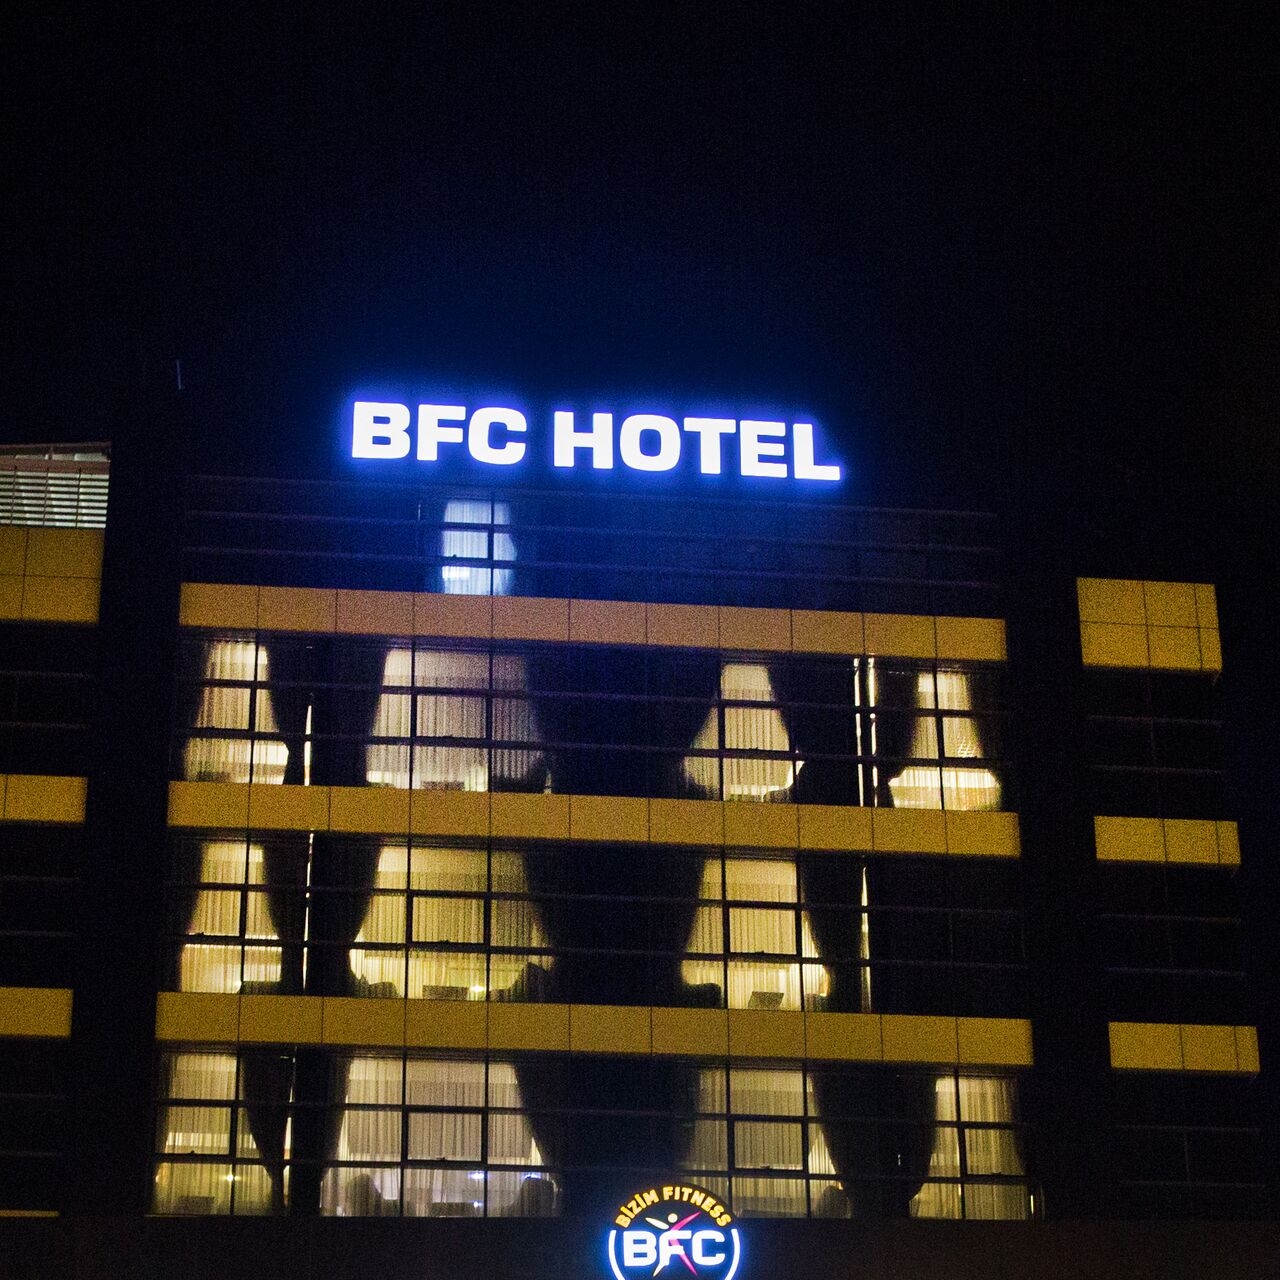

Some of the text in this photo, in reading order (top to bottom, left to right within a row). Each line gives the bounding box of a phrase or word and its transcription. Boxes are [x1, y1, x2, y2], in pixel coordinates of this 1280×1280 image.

[352, 401, 843, 483] BFC HOTEL
[615, 1185, 733, 1229] BİZİM FITNESS
[622, 1229, 726, 1268] BFC
